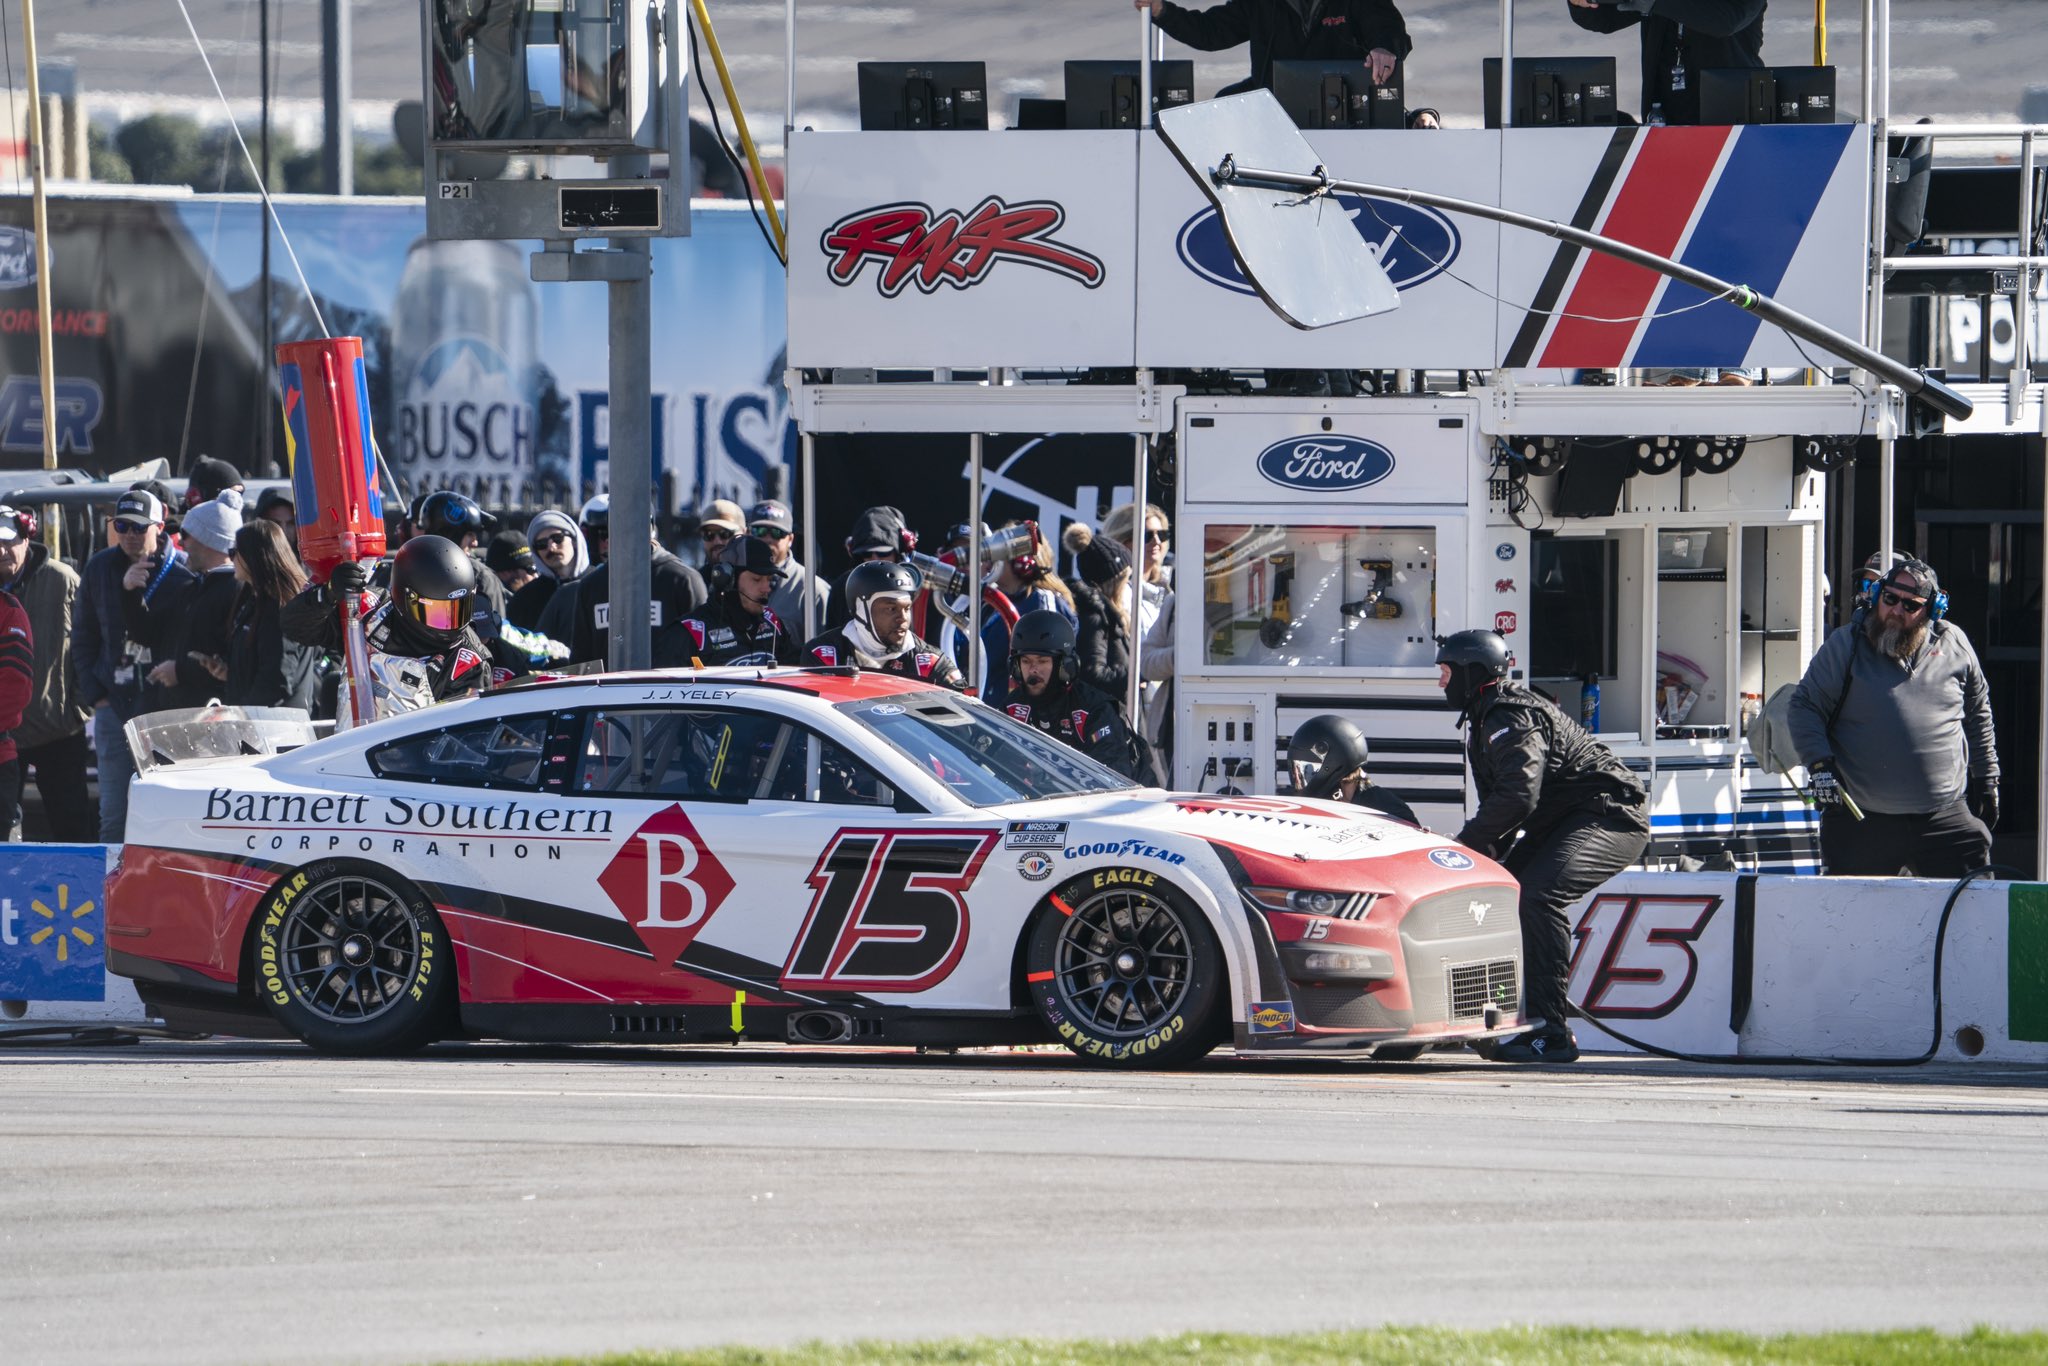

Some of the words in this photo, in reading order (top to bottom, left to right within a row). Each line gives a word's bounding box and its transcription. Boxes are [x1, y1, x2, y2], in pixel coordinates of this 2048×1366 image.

[441, 184, 470, 199] P21
[821, 195, 1105, 298] RWR
[400, 401, 537, 468] BUSCH
[1284, 442, 1367, 480] Ford
[1498, 545, 1513, 558] Ford
[1496, 615, 1516, 630] CRC
[642, 690, 655, 700] J.
[659, 690, 673, 700] J.
[680, 690, 737, 700] YELEY
[1099, 725, 1112, 737] 75
[202, 787, 370, 823] Barnett
[384, 796, 614, 833] Southern
[1013, 834, 1030, 843] CUP
[1029, 834, 1057, 843] SERIES
[1025, 823, 1060, 831] NASCAR
[246, 834, 561, 860] CORPORATION
[1063, 839, 1186, 866] GOODYEAR
[1434, 851, 1469, 867] Ford
[636, 832, 707, 928] B
[1092, 868, 1159, 889] EAGLE
[777, 826, 1004, 993] 15
[260, 871, 310, 1005] GOODYEAR
[1302, 919, 1332, 941] 15
[409, 931, 434, 1002] EAGLE
[1566, 893, 1725, 1020] 15
[1251, 1013, 1291, 1022] SUNOCO
[1058, 1014, 1185, 1060] GOODYEAR
